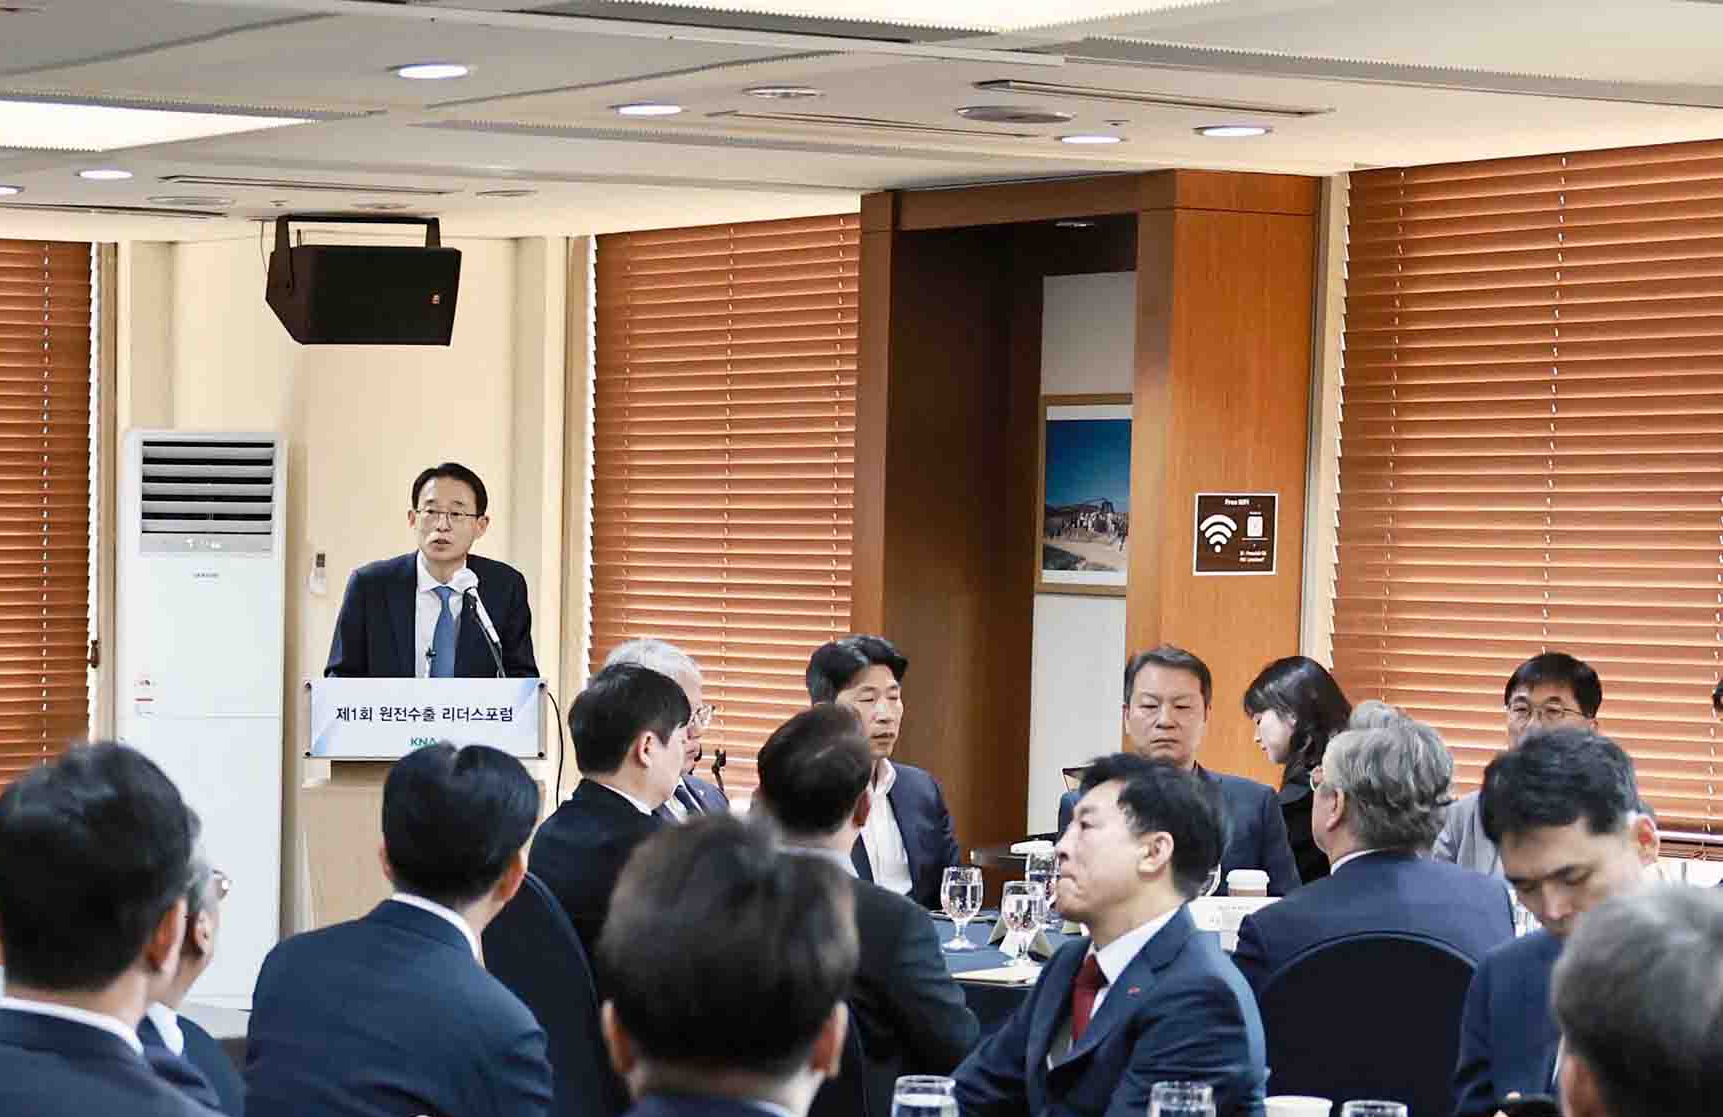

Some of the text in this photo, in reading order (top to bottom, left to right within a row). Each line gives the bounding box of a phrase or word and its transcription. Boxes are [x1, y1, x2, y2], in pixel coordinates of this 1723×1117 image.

[336, 706, 514, 724] 제1회 원전수출 리더스포럼
